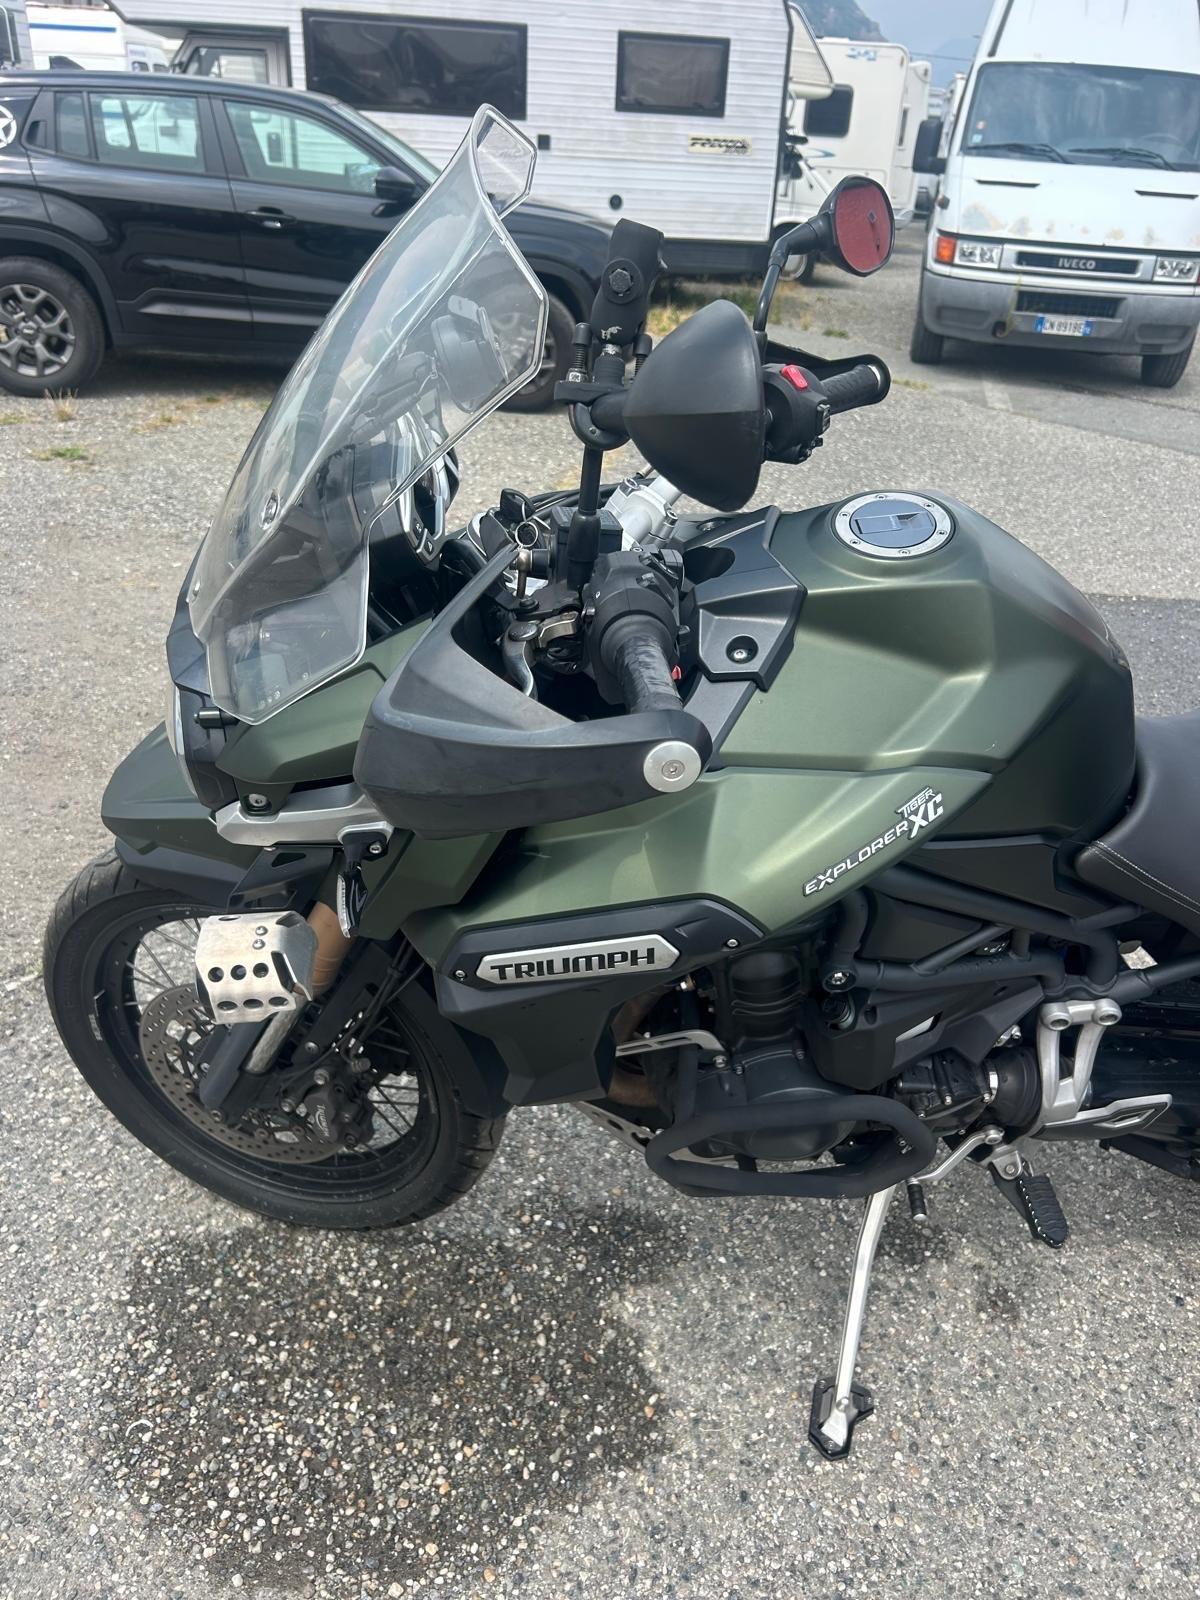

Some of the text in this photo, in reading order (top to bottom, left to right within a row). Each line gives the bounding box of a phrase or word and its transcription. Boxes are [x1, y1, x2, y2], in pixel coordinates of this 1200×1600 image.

[1058, 257, 1096, 270] IVECO
[897, 787, 935, 818] TIGER
[804, 793, 944, 895] EXPLORER XC
[490, 947, 655, 980] TRIUMPH
